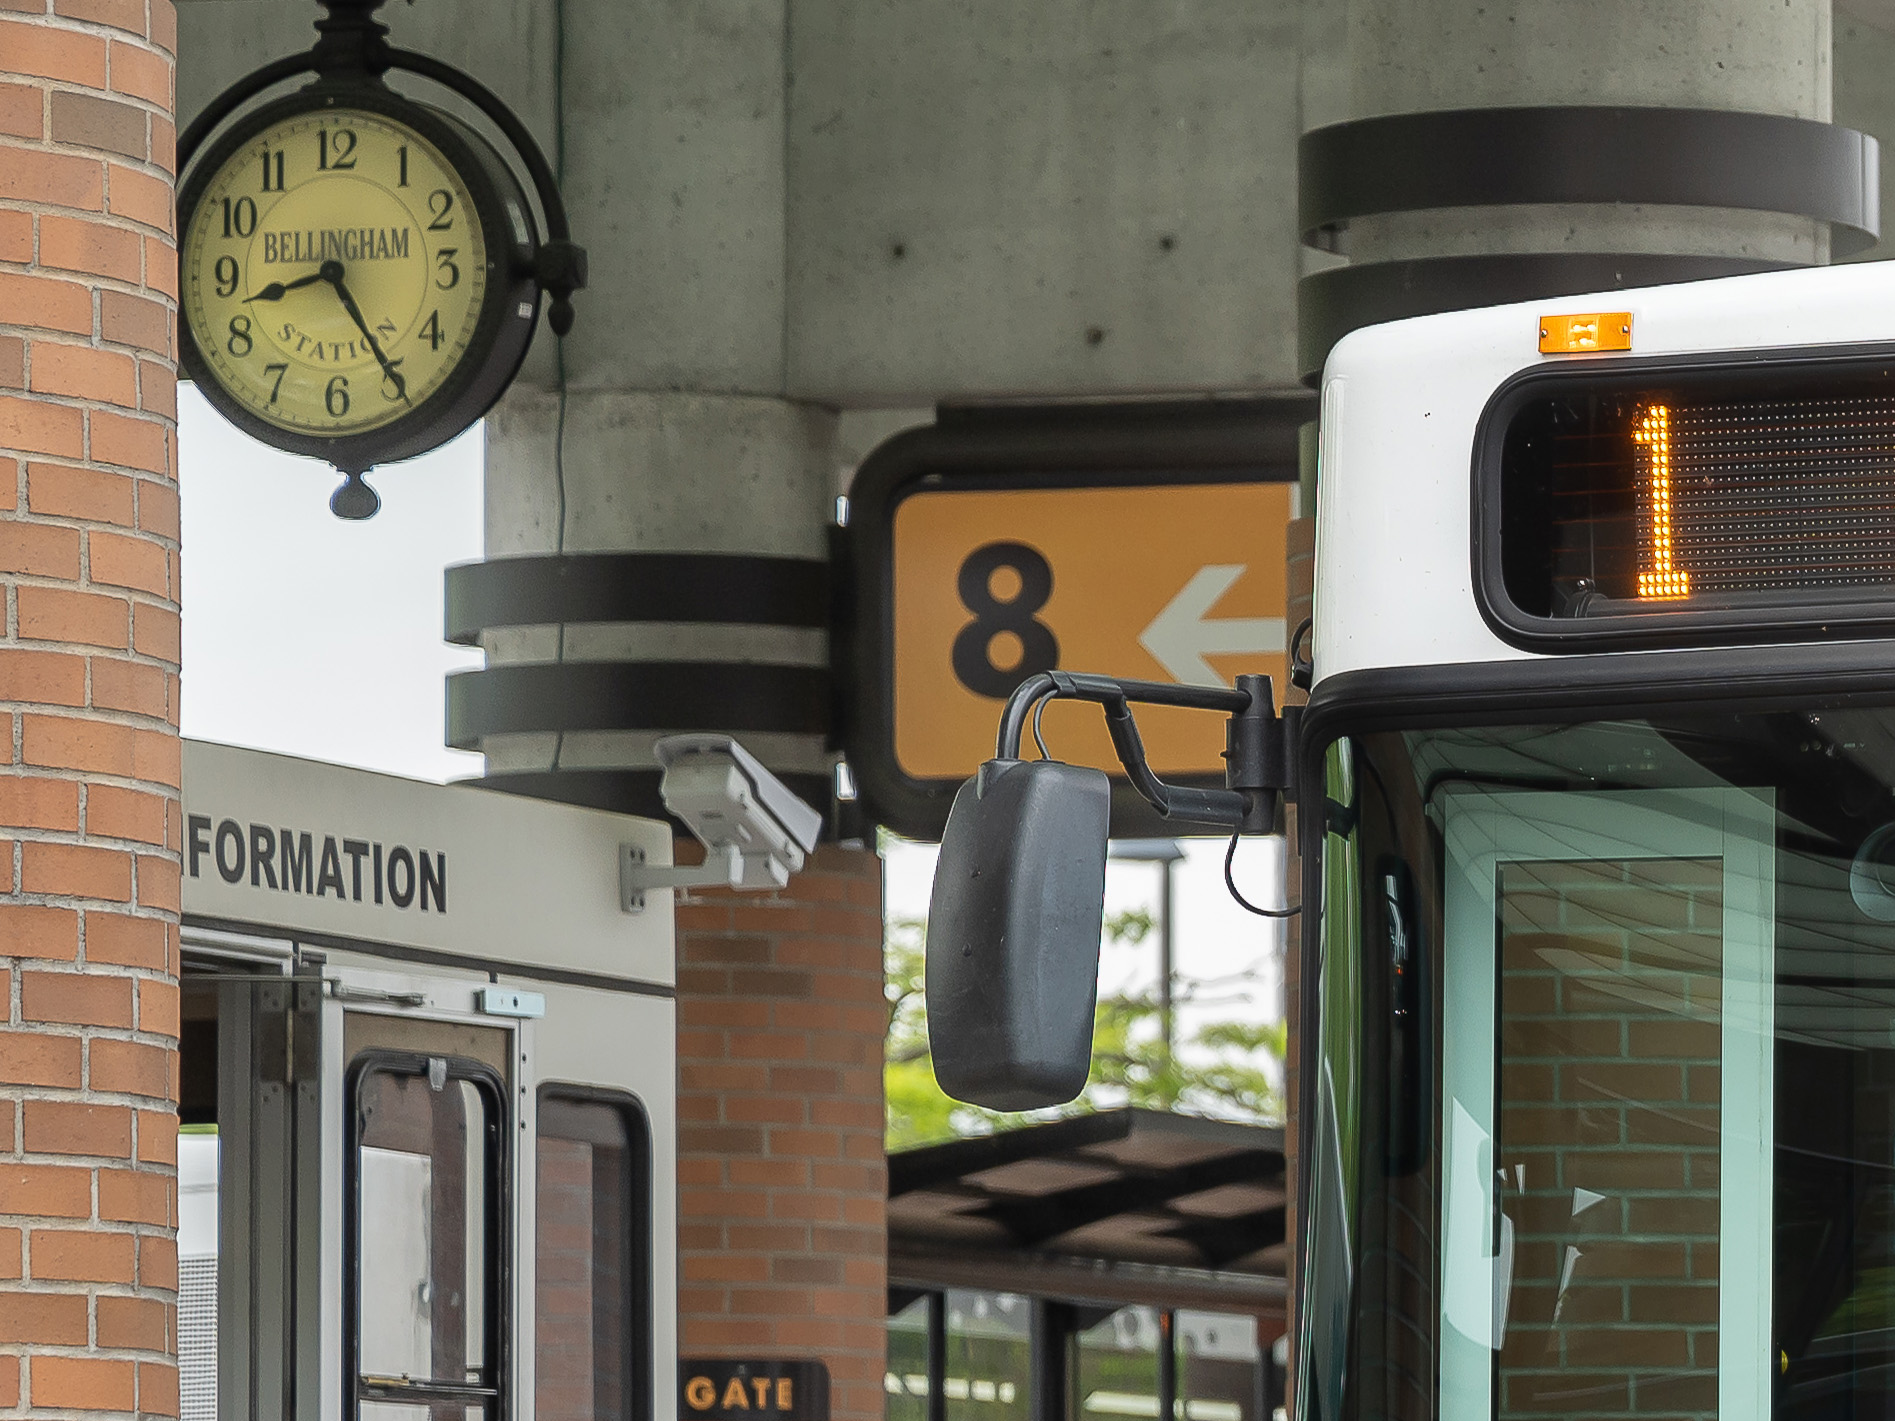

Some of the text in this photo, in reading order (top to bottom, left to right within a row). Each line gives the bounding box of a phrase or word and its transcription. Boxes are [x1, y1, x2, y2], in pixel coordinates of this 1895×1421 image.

[261, 149, 285, 193] 11
[316, 129, 357, 171] 12
[397, 145, 408, 188] 1
[221, 196, 258, 239] 10
[427, 189, 454, 232] 2
[263, 227, 410, 264] BELLINGHAM
[215, 254, 240, 298] 9
[435, 248, 460, 291] 3
[227, 314, 253, 358] 8
[277, 316, 398, 363] STATION
[418, 309, 447, 352] 4
[263, 363, 289, 404] 7
[324, 374, 350, 418] 6
[381, 356, 405, 402] 5
[1633, 404, 1692, 602] 1
[952, 540, 1060, 699] 8
[182, 815, 447, 926] FORMATION
[685, 1376, 794, 1413] GATE
